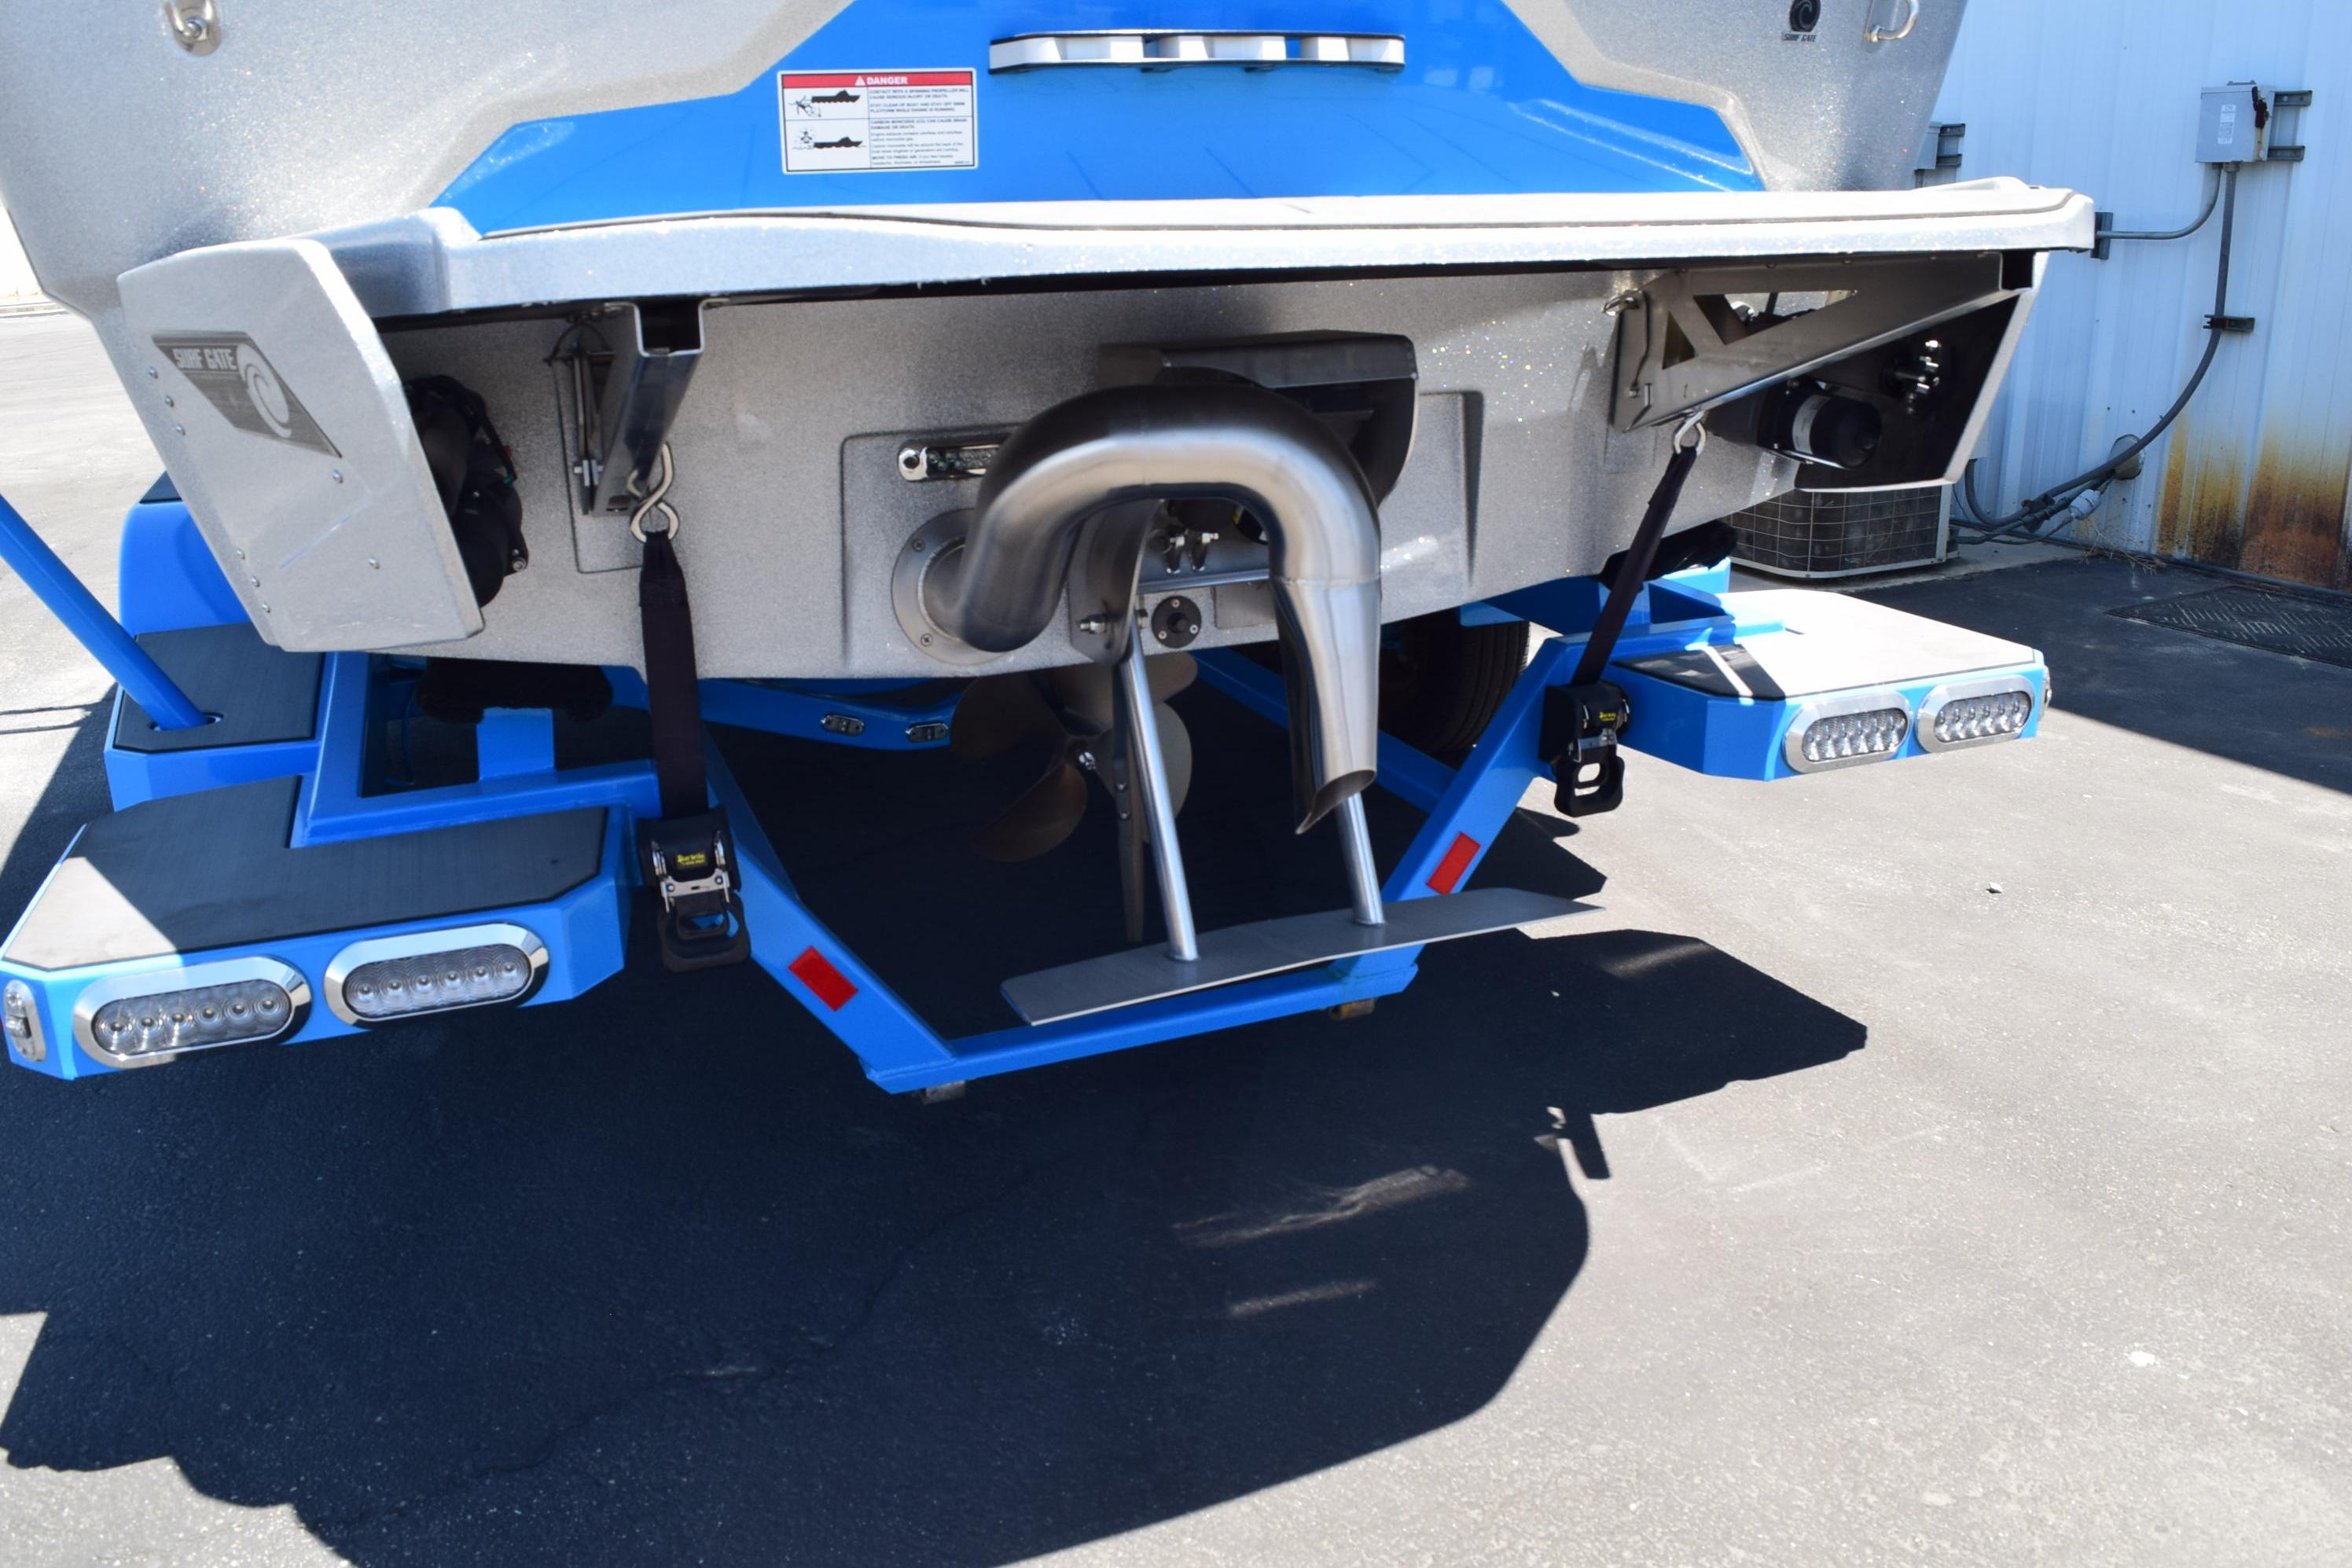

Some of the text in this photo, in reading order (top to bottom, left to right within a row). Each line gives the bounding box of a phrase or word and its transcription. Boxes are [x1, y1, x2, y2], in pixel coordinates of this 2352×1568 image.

[866, 76, 908, 85] DANGER
[171, 348, 237, 370] SURF GATE
